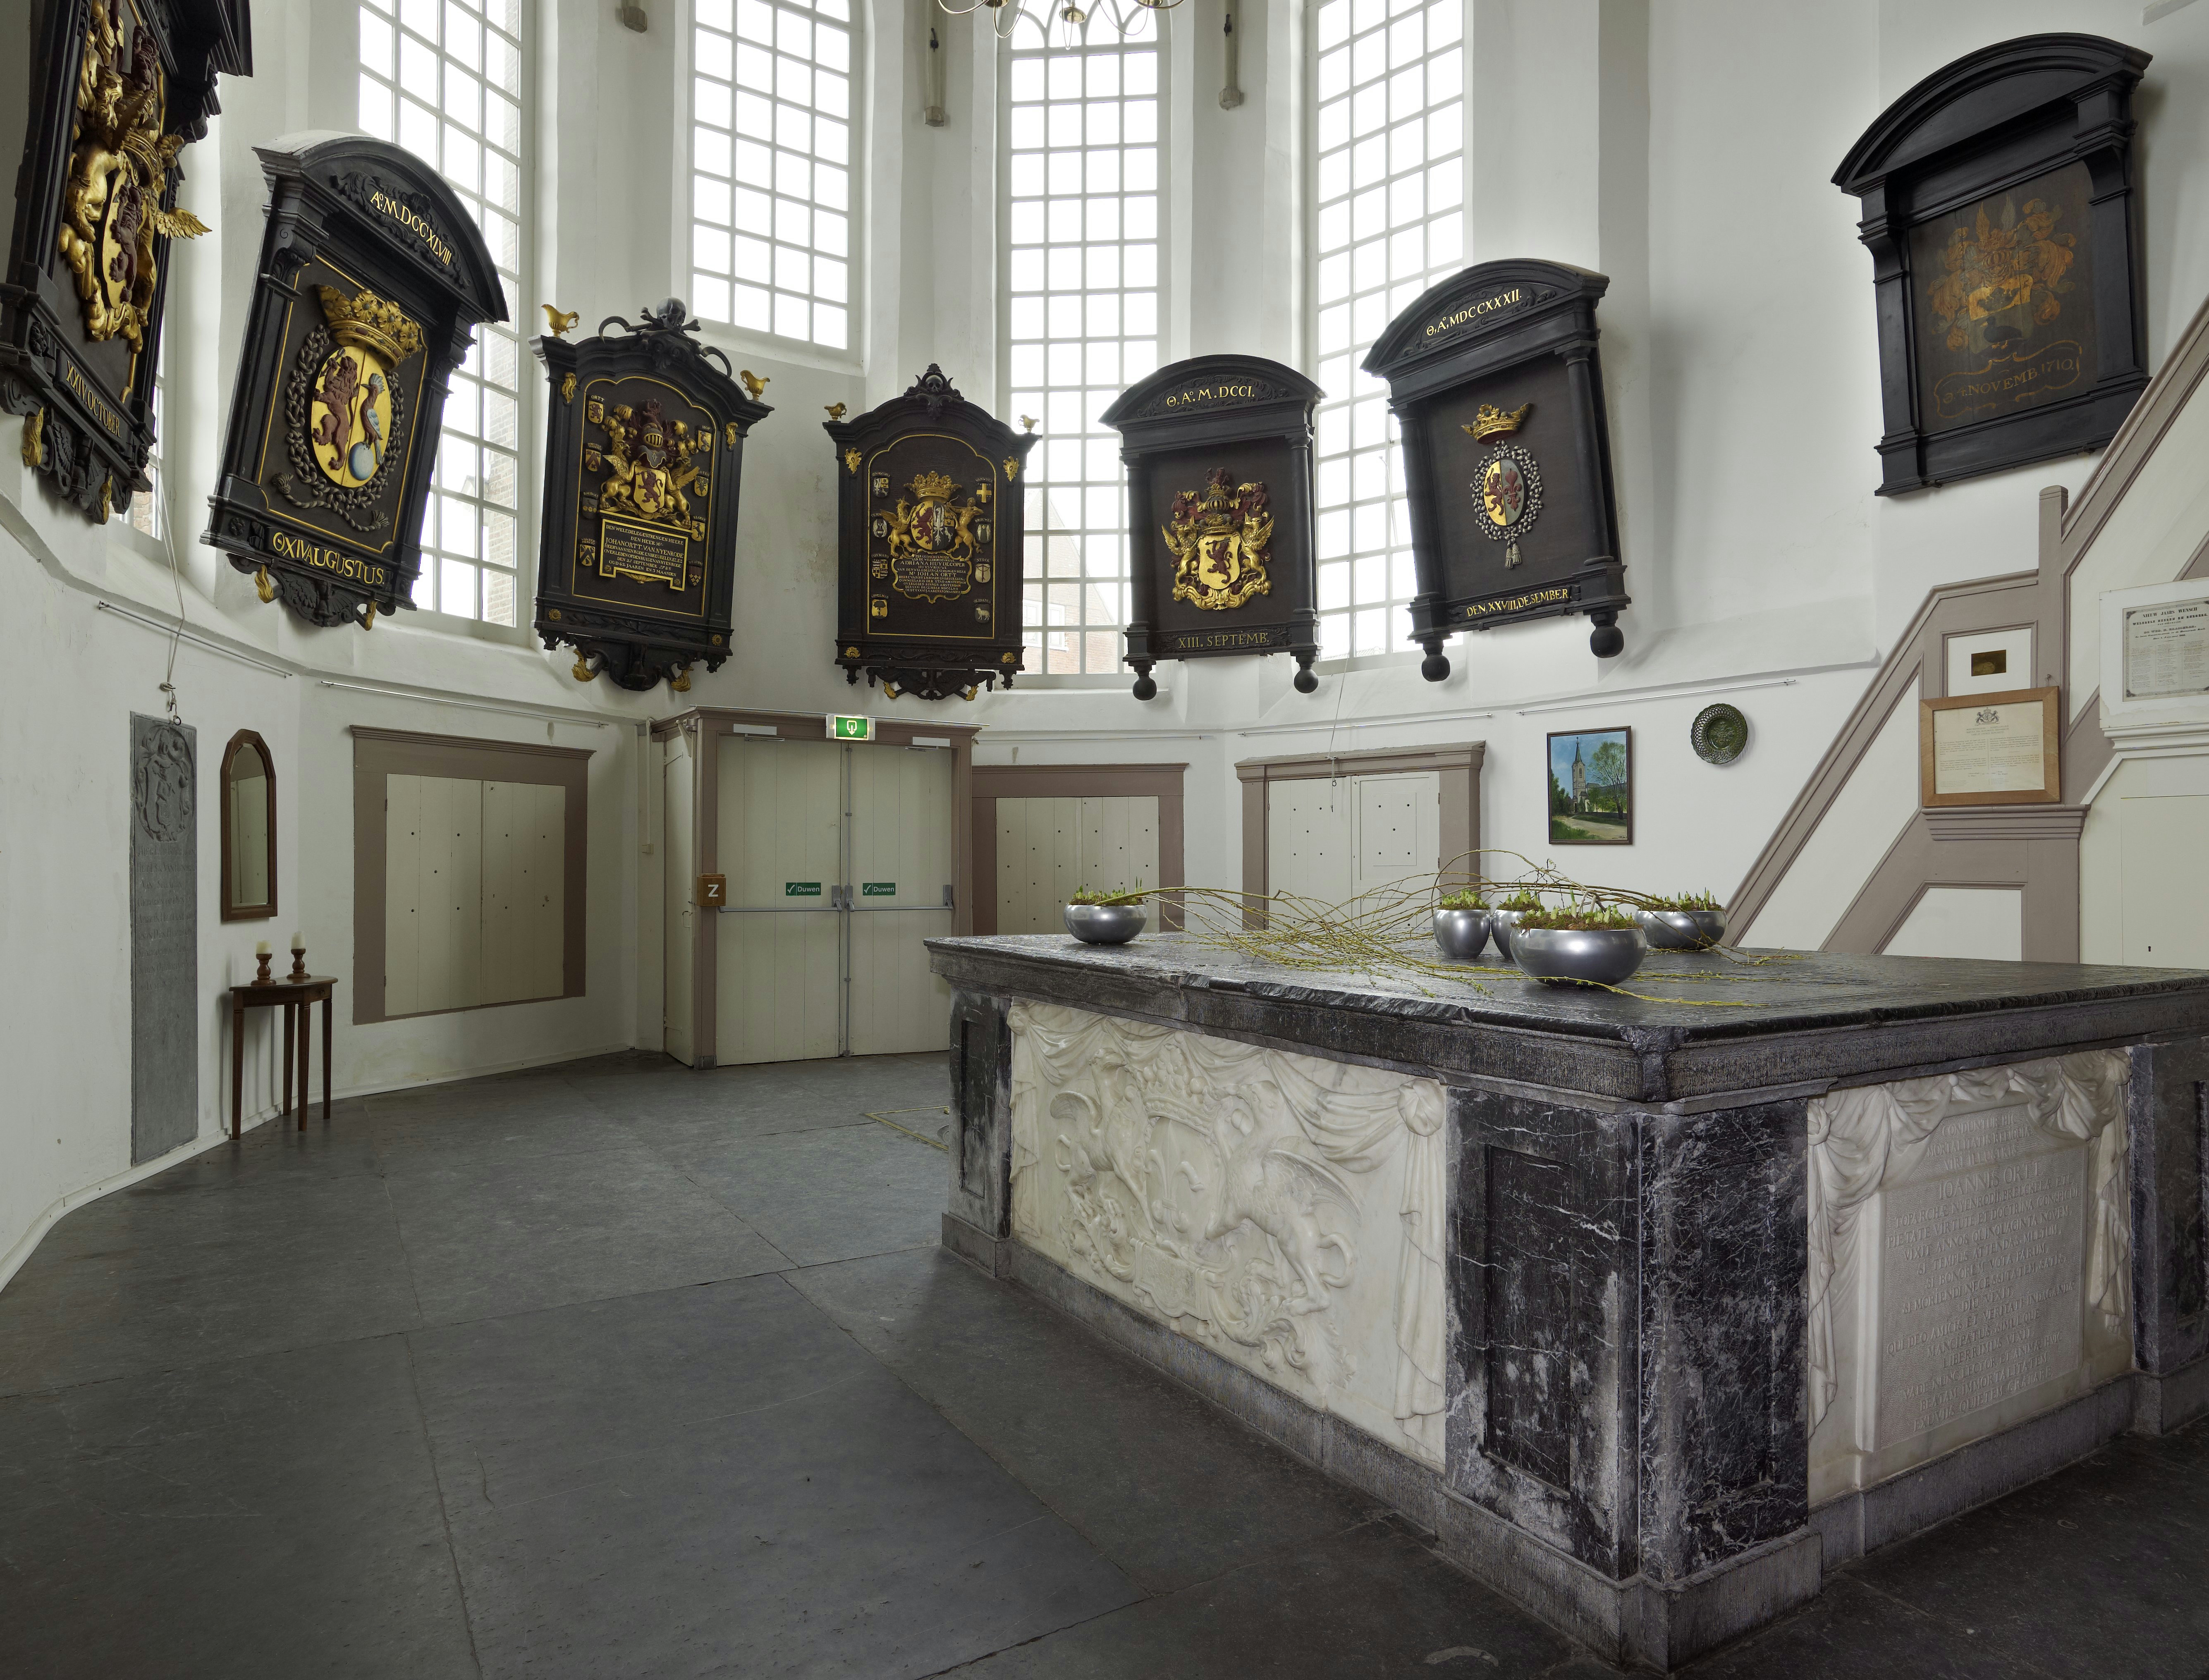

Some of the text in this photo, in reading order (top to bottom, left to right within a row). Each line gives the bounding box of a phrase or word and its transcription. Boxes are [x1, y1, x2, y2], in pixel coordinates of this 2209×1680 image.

[633, 560, 658, 569] SEPTEMBER
[708, 884, 719, 897] Z
[1942, 1117, 1998, 1137] CONDUNTUR
[1927, 1135, 1991, 1157] MORTALITATIS
[1944, 1155, 1963, 1171] VIRI
[1939, 1170, 1999, 1200] IOANNIS
[1887, 1226, 1931, 1249] PIETATE
[1991, 1199, 2034, 1221] DOCTRINA
[1895, 1204, 1949, 1228] TOPARCHÆ
[1904, 1244, 1932, 1261] VIXIT
[1936, 1234, 1969, 1253] ANNOS
[1917, 1260, 1927, 1275] SI
[1933, 1251, 1969, 1271] TEMPUS
[1925, 1277, 1935, 1289] SI
[1990, 1253, 2013, 1270] VOTA
[1902, 1302, 1912, 1314] SI
[1915, 1286, 1962, 1311] MORIENDI
[1962, 1298, 1979, 1312] DIU
[1886, 1336, 1905, 1357] QUI
[1966, 1314, 1978, 1328] ET
[1943, 1337, 2003, 1368] LIBERRIMUS
[1920, 1387, 1958, 1412] BEATAM
[1960, 1385, 2003, 1413] QUIETEM
